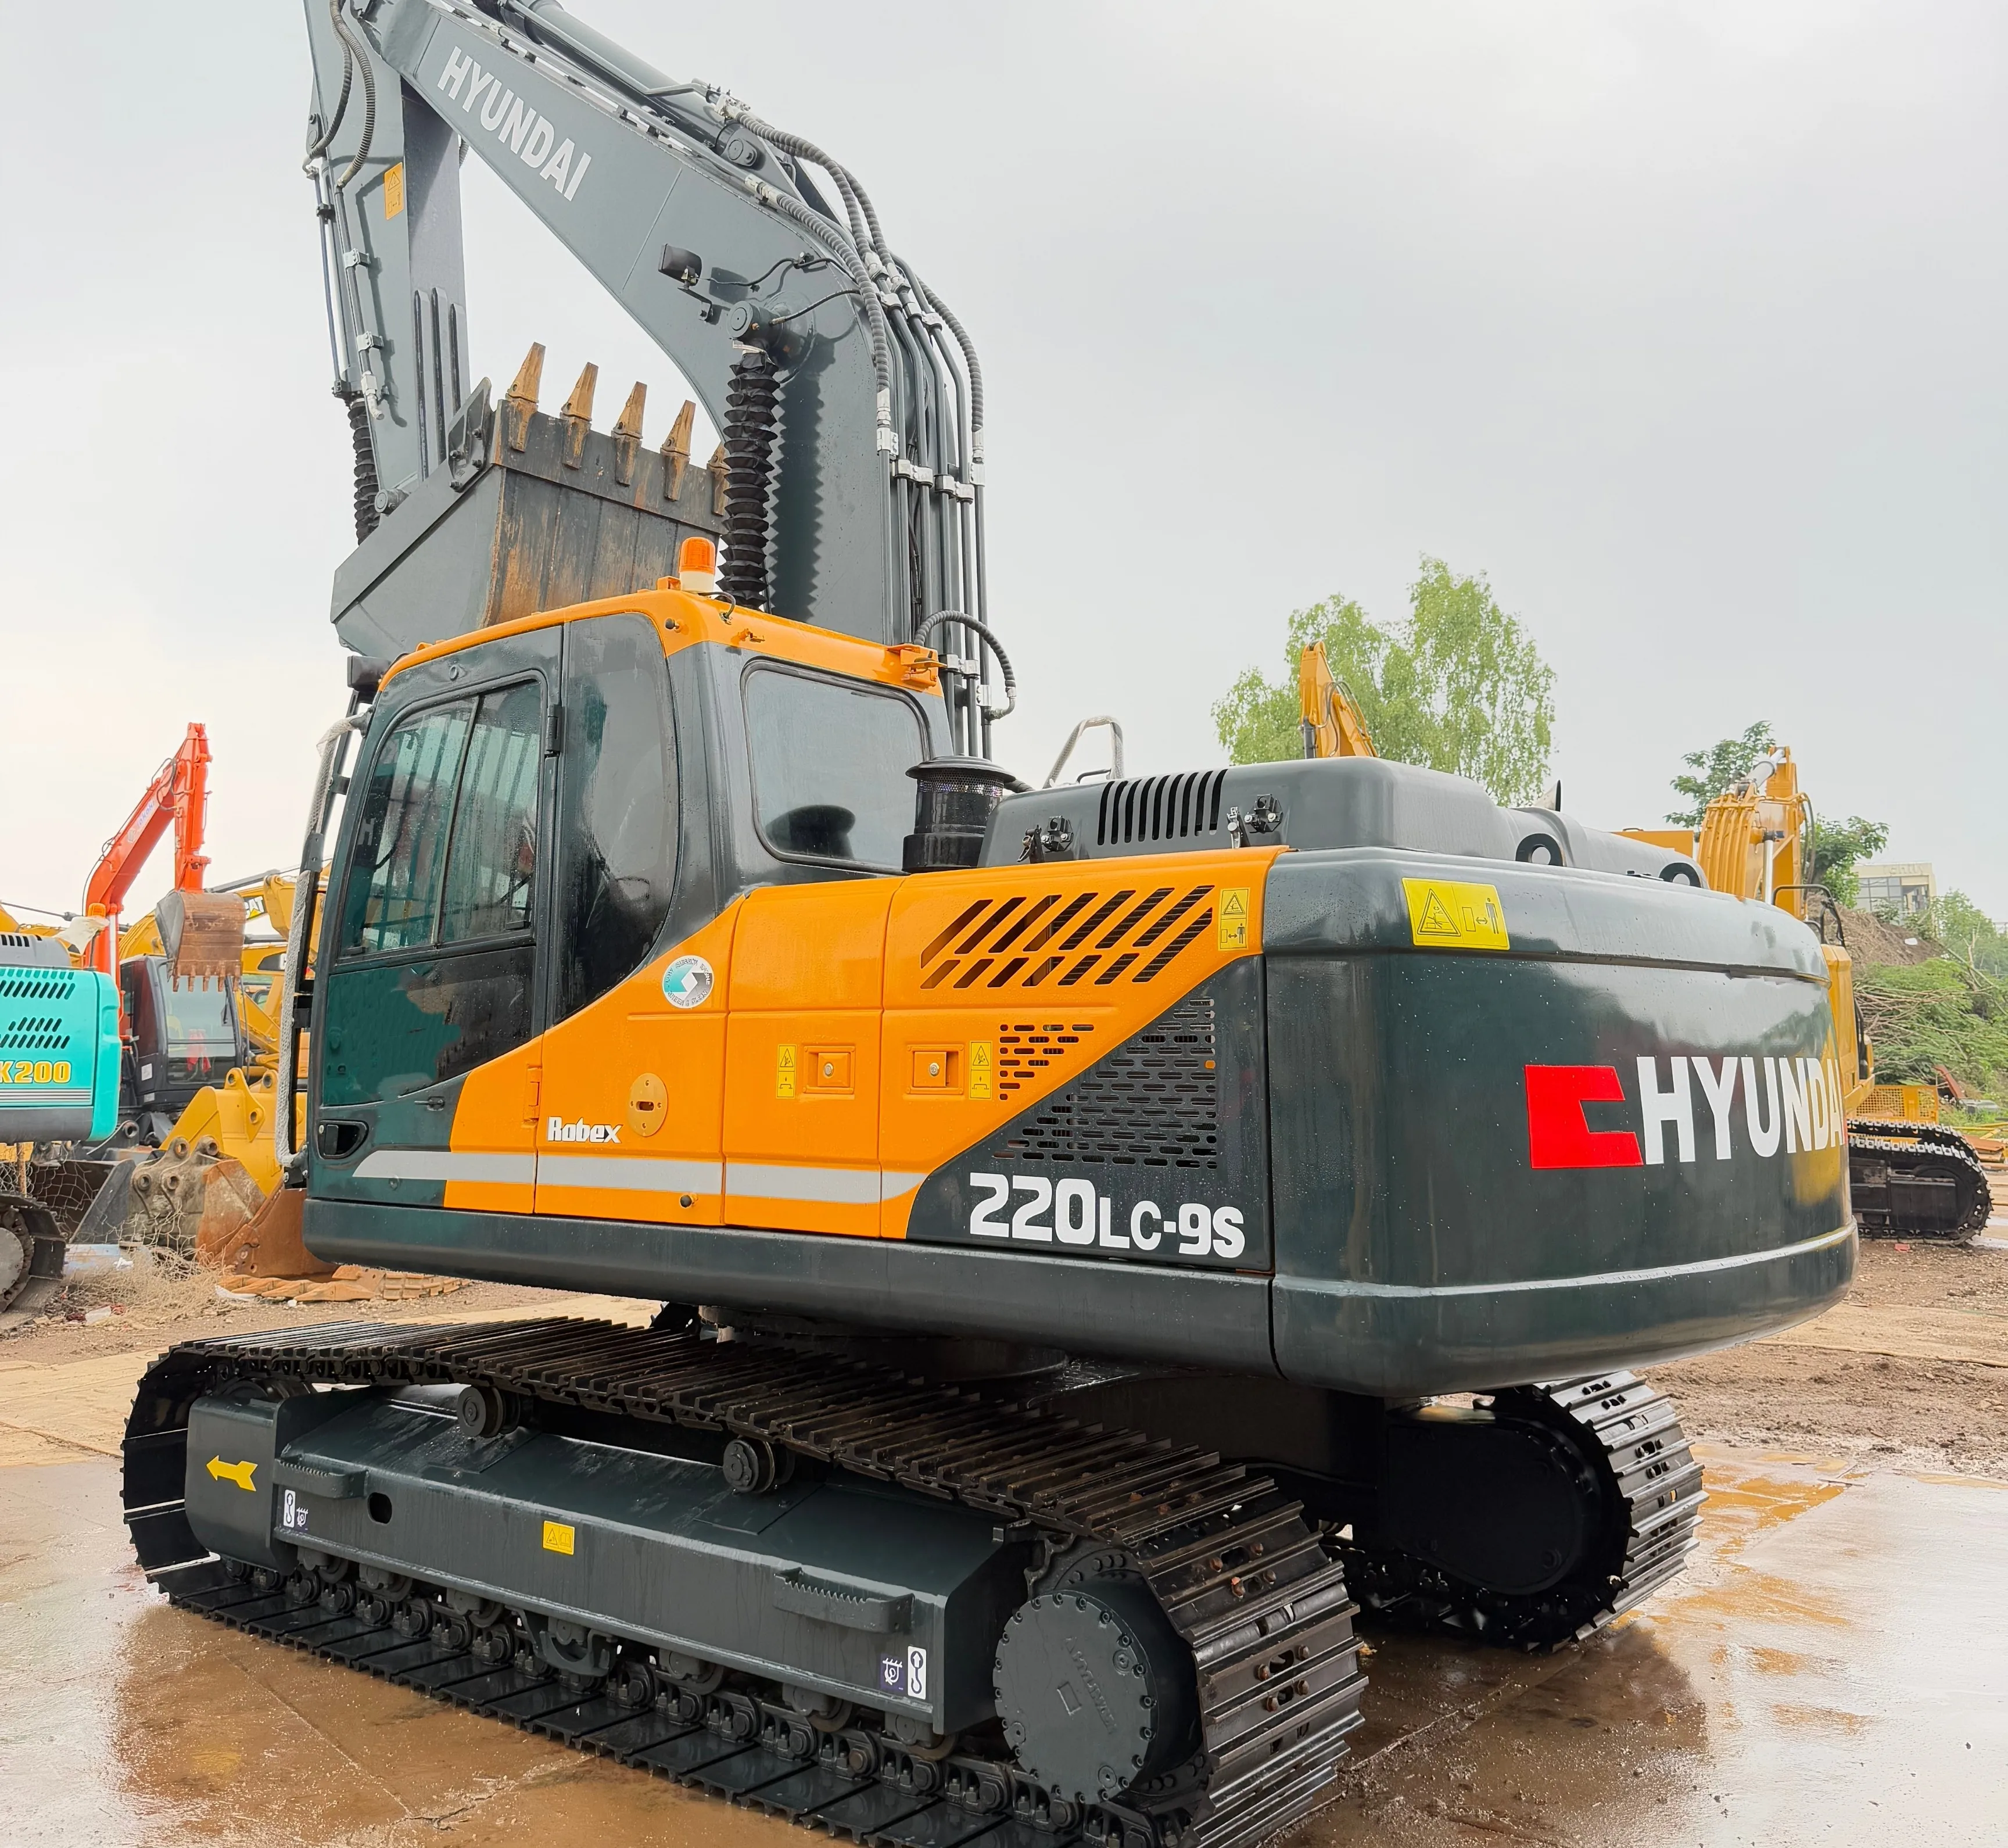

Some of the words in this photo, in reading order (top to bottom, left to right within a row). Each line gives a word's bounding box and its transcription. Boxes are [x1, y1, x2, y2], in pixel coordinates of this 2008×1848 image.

[438, 46, 591, 201] HYUNDAI
[547, 1116, 623, 1143] Robex
[970, 1172, 1245, 1258] 220LC-9S
